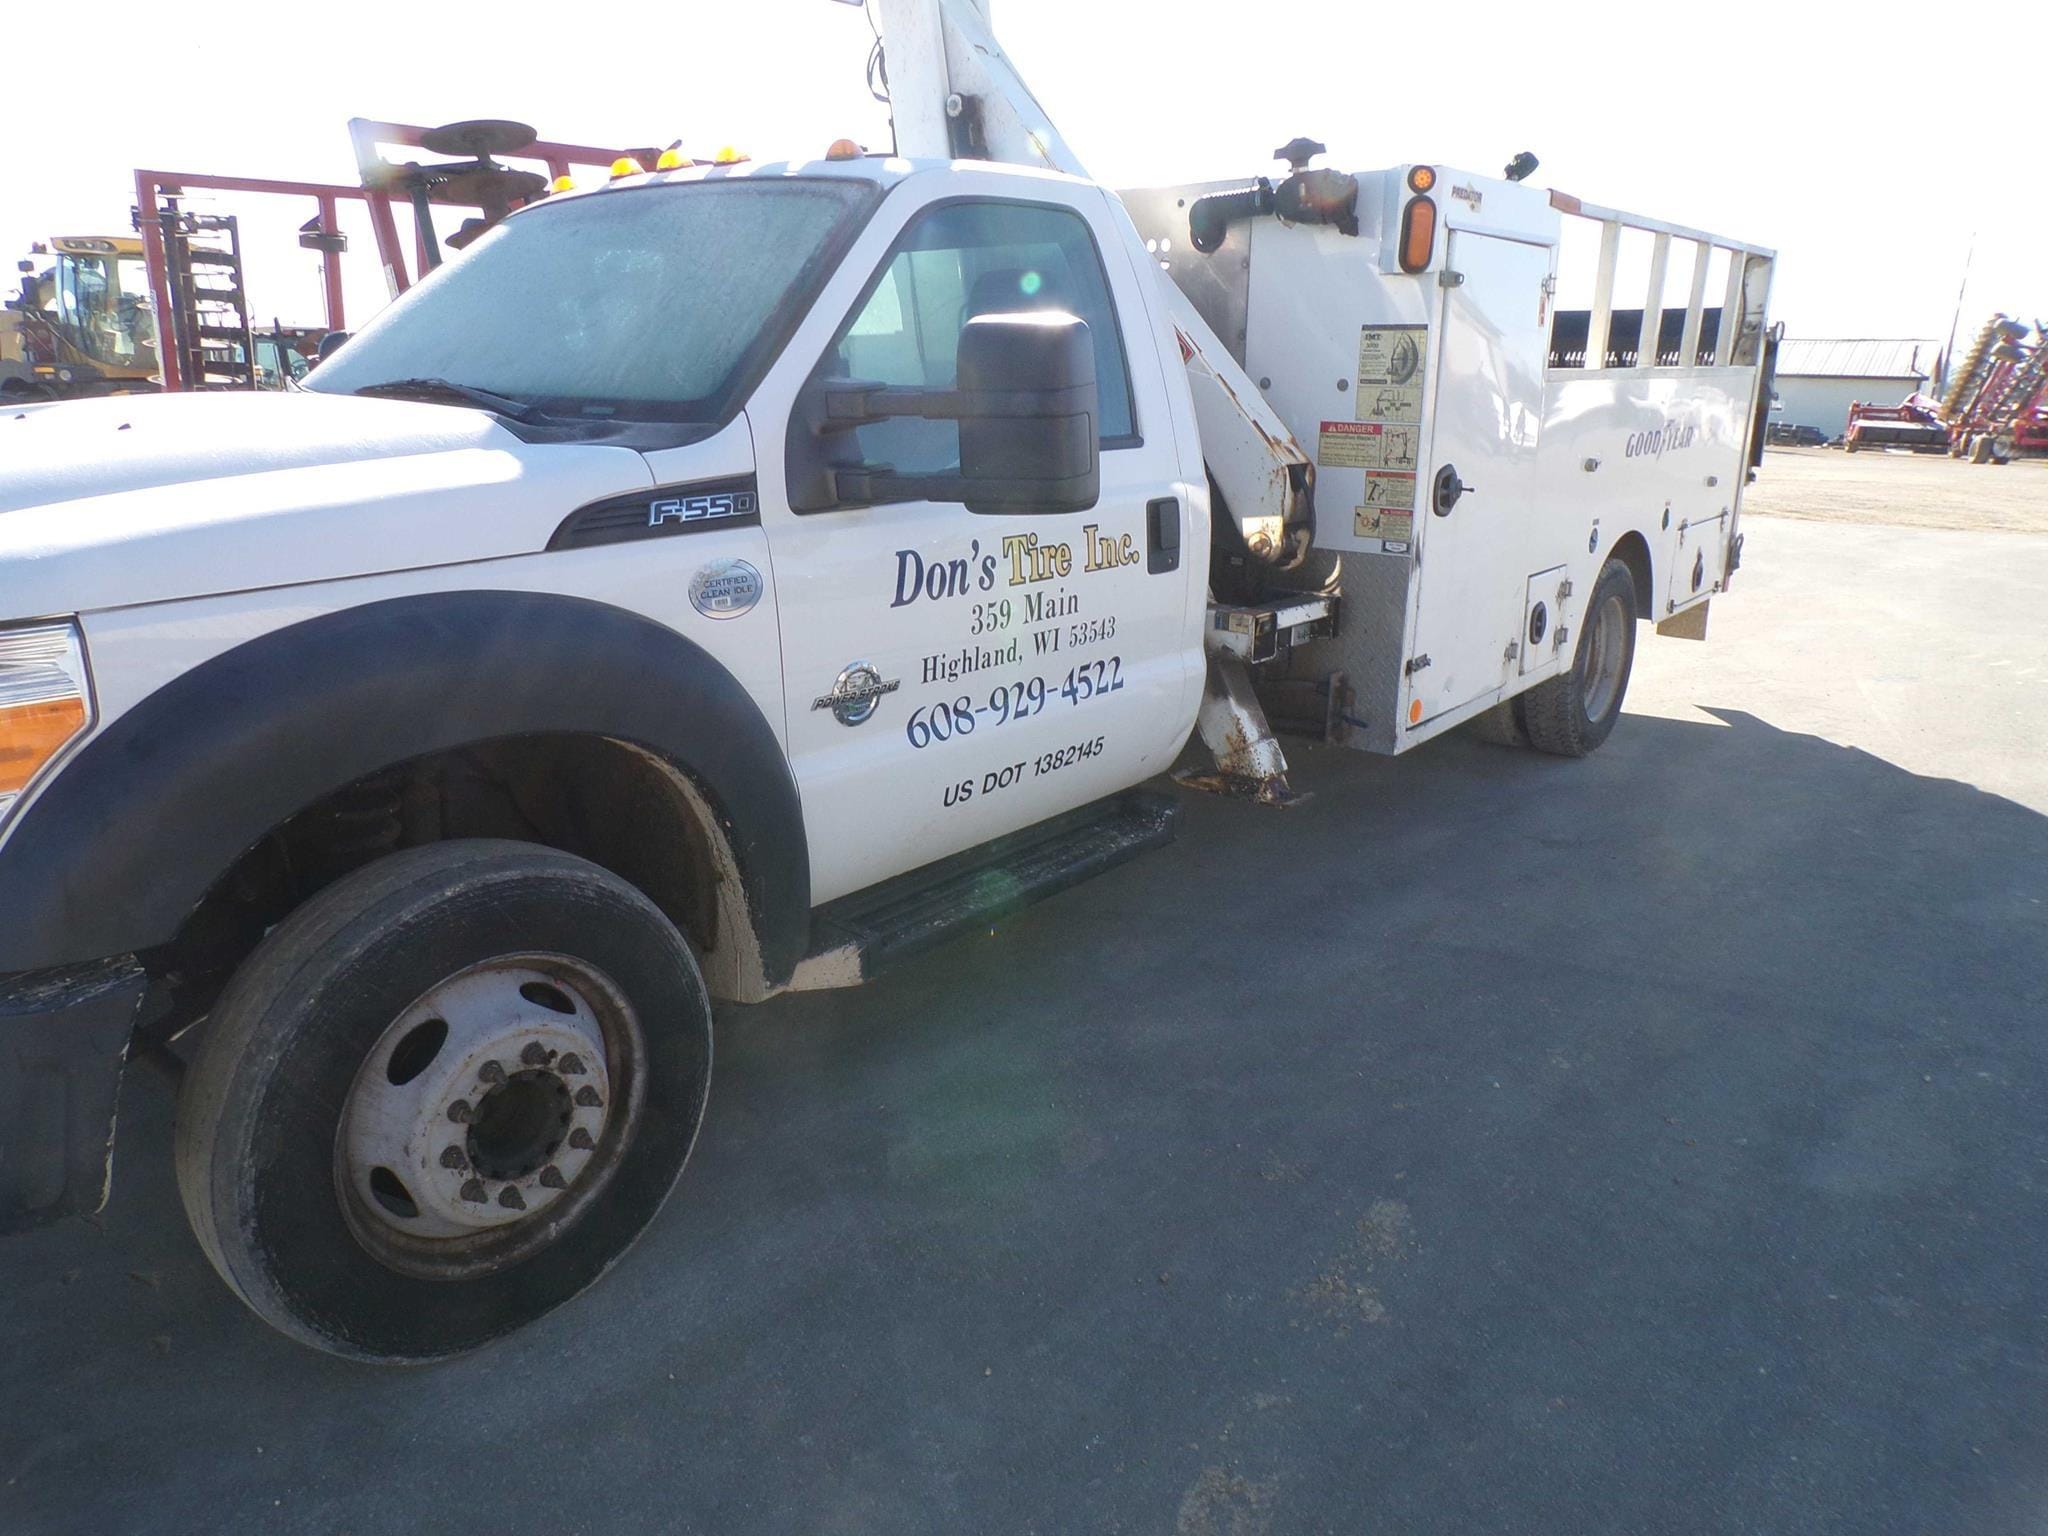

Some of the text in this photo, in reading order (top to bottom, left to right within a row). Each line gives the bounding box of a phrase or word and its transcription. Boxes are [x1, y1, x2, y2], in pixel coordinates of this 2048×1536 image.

[1337, 423, 1375, 434] DANGER
[1625, 419, 1694, 463] GOODYEAR
[648, 491, 757, 527] F-550
[703, 575, 748, 589] CERTIFIED
[890, 523, 1140, 608] Don's Tire Inc.
[700, 584, 753, 600] CLEAN IDLE
[971, 587, 1079, 636] 359 Main
[921, 616, 1116, 684] Highland, WI 53543
[814, 690, 858, 710] POWER
[857, 680, 900, 701] STROKE
[906, 656, 1124, 749] 608-929-4522
[943, 736, 1105, 807] US DOT 1382145
